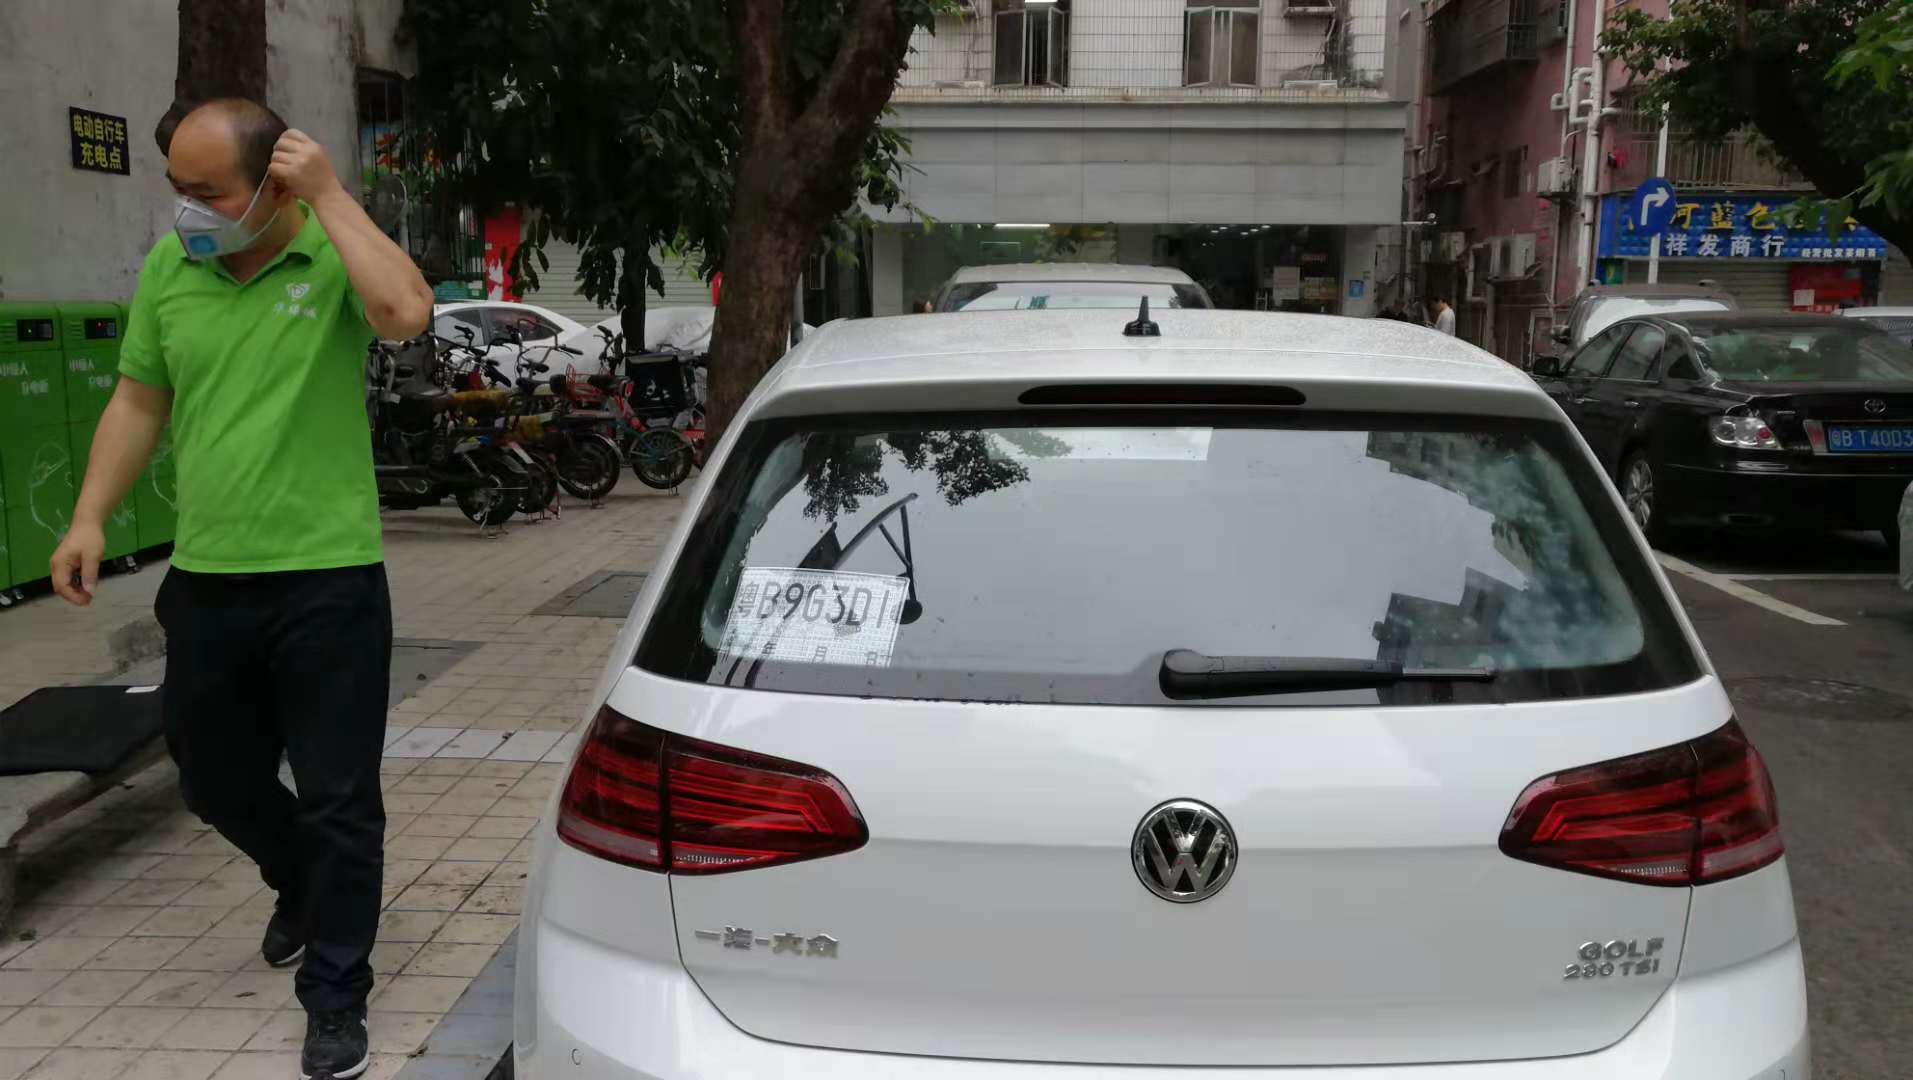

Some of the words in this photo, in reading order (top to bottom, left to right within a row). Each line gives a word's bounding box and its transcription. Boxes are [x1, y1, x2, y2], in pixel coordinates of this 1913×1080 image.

[73, 112, 125, 144] 电动自行车
[80, 142, 122, 169] 充电点
[1665, 233, 1786, 257] 祥发商行
[1578, 937, 1664, 961] GOLF
[1563, 962, 1615, 979] 280
[1619, 958, 1661, 976] TSI
